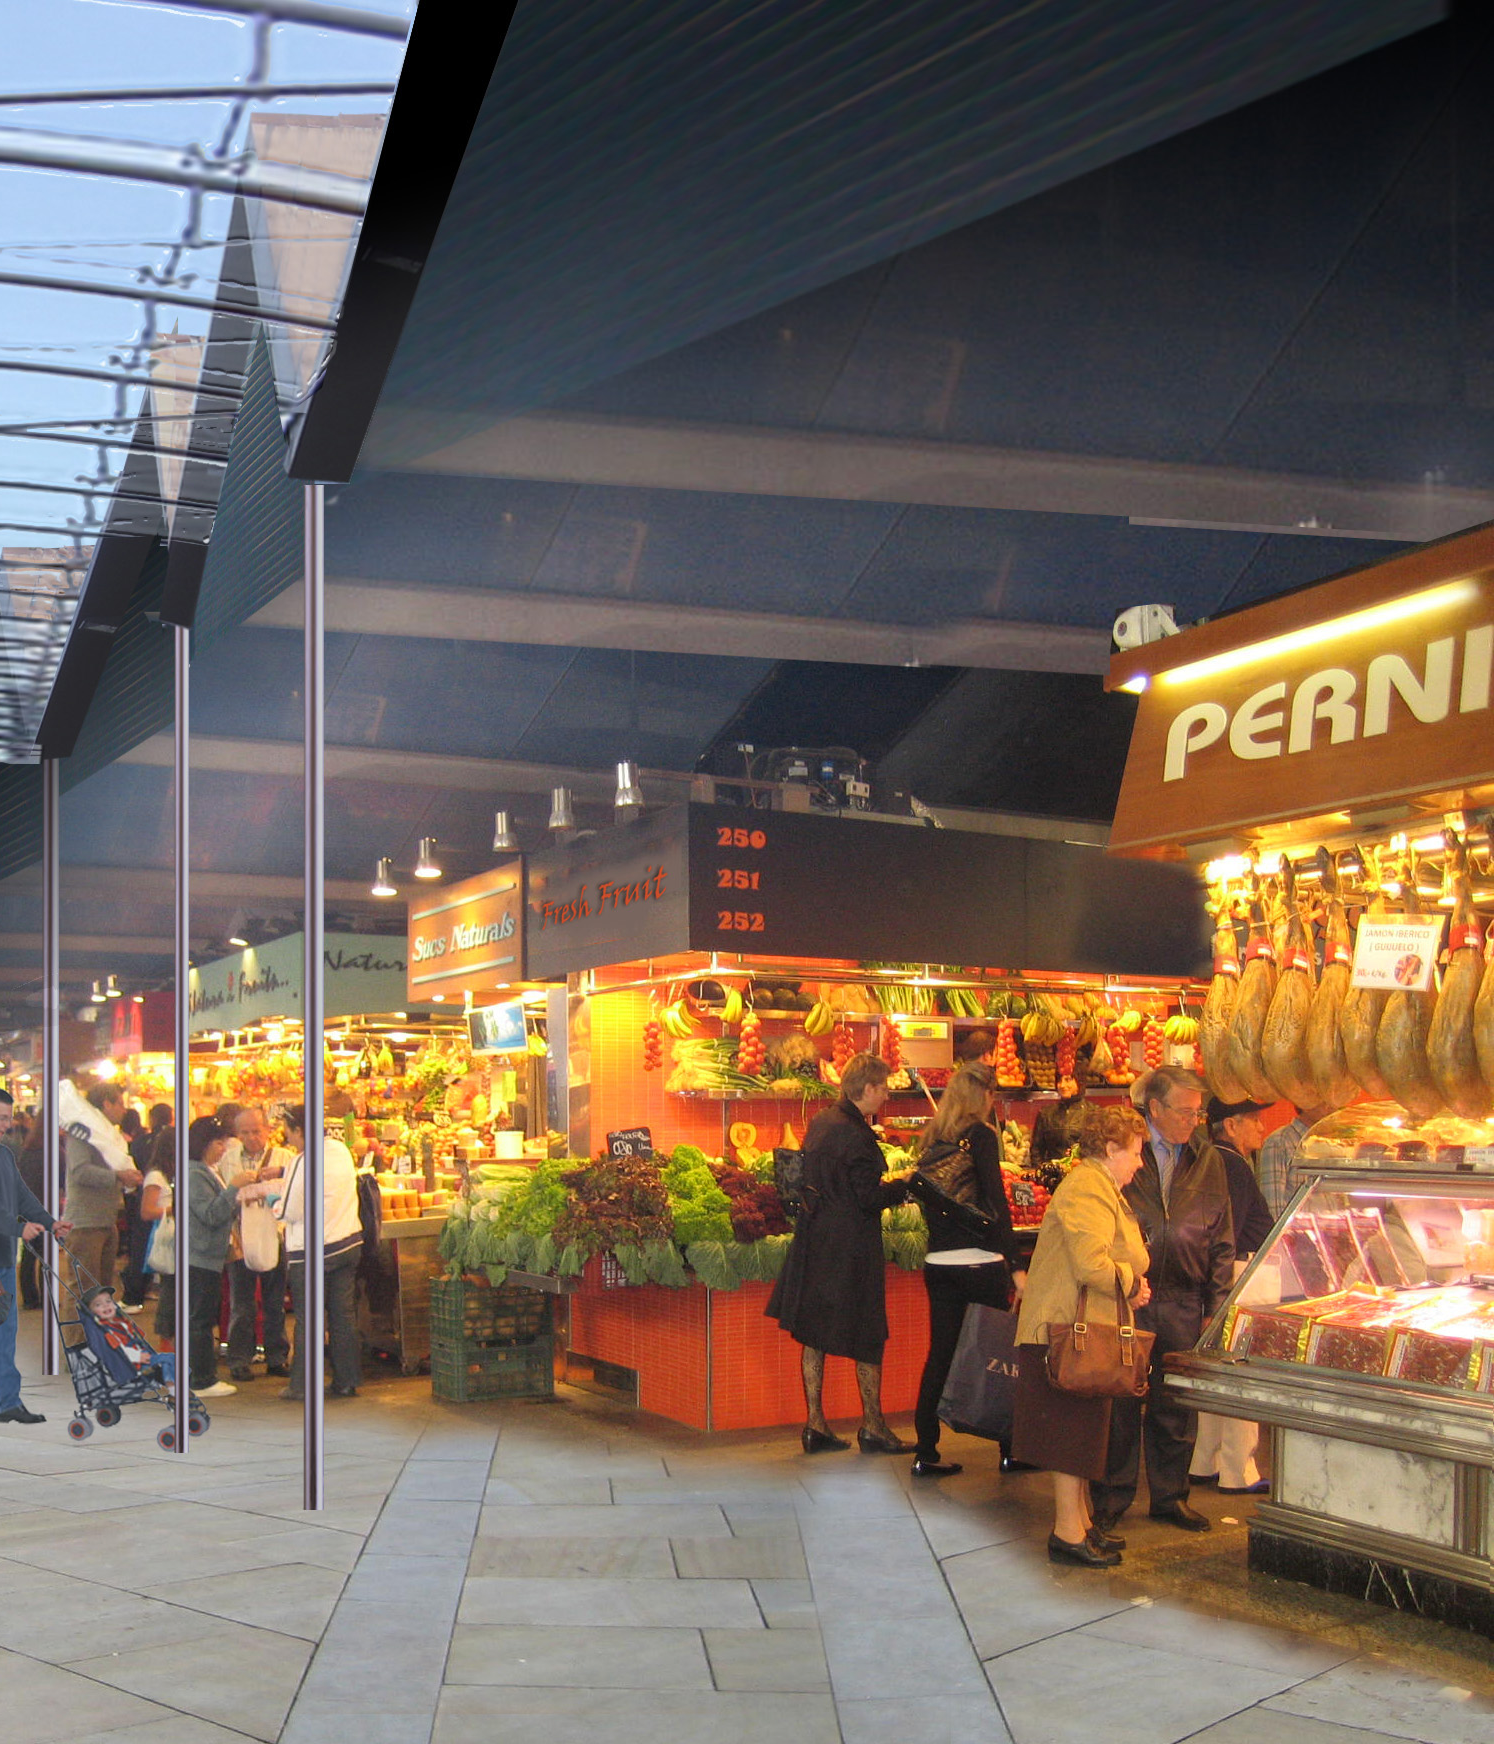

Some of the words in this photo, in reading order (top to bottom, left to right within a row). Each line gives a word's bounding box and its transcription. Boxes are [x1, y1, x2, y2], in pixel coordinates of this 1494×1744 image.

[1164, 625, 1493, 782] PERNI
[717, 827, 767, 849] 250
[717, 868, 760, 891] 251
[542, 886, 592, 930] Fresh
[598, 865, 668, 915] Fruit
[717, 910, 765, 932] 252
[412, 936, 447, 962] Sucs
[450, 911, 516, 953] Naturals
[1396, 930, 1430, 939] IBERICO
